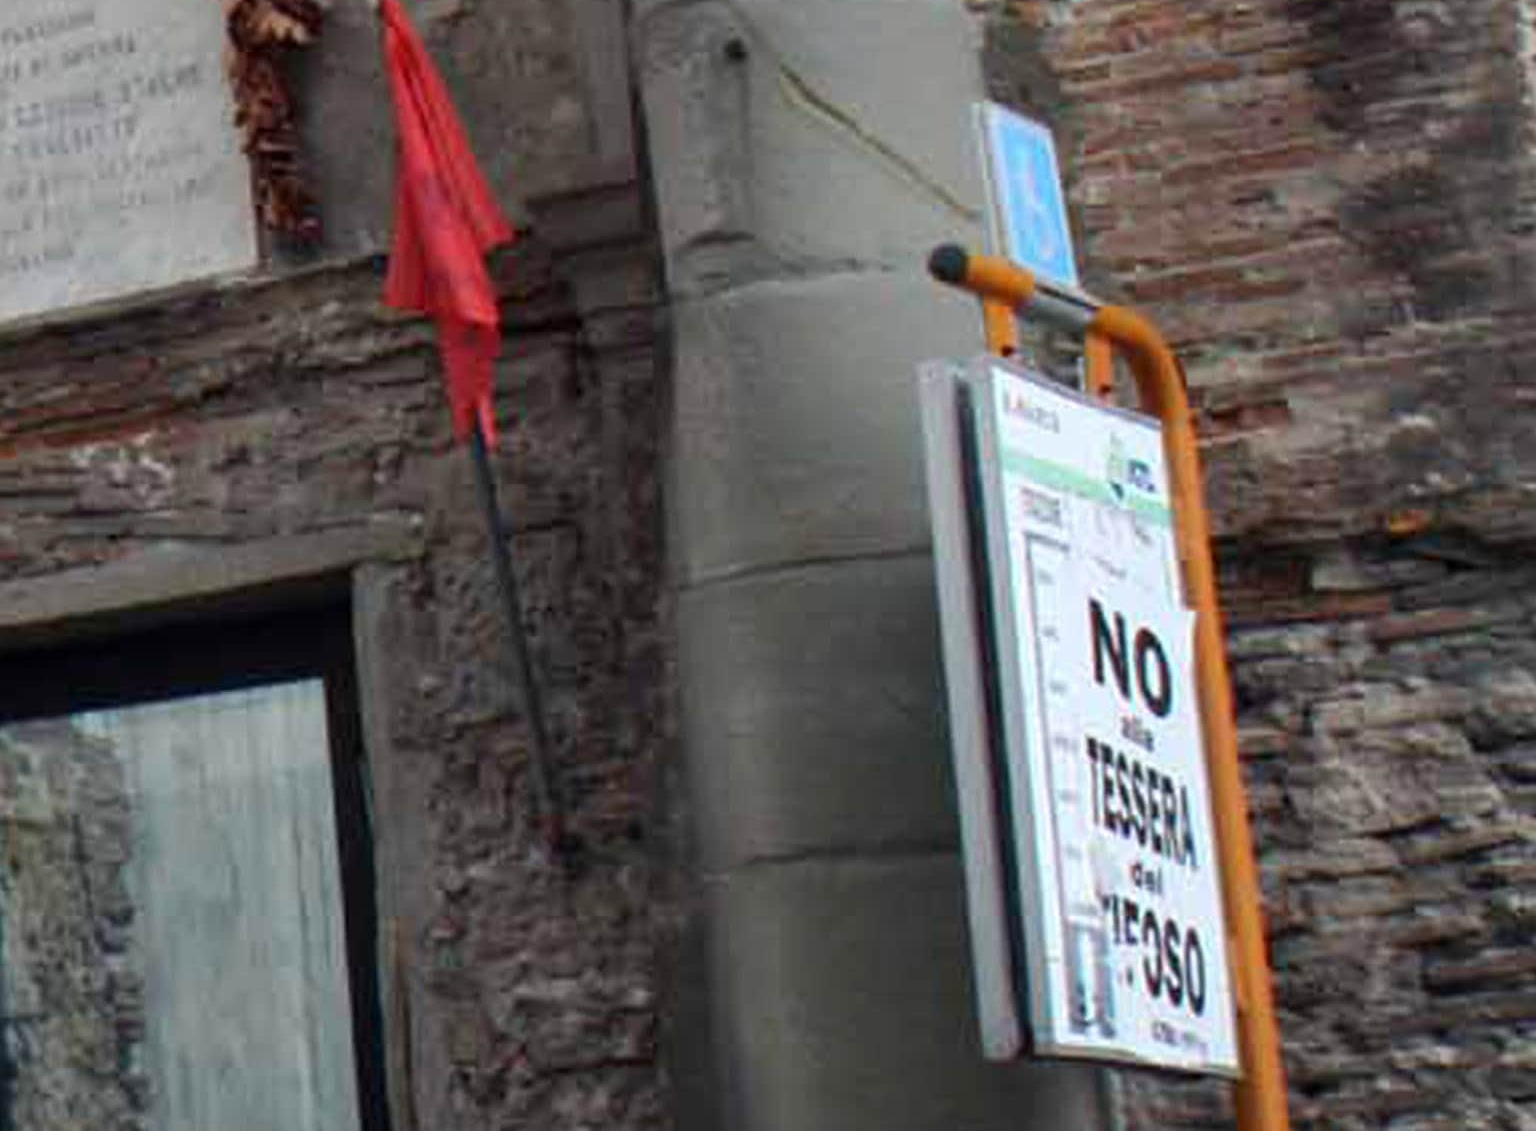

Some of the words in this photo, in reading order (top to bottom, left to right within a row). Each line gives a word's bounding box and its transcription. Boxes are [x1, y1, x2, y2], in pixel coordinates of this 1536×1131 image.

[1087, 597, 1173, 718] NO
[1085, 735, 1199, 872] TESSERA
[1131, 861, 1163, 895] del
[1101, 893, 1207, 1017] IFOSO
